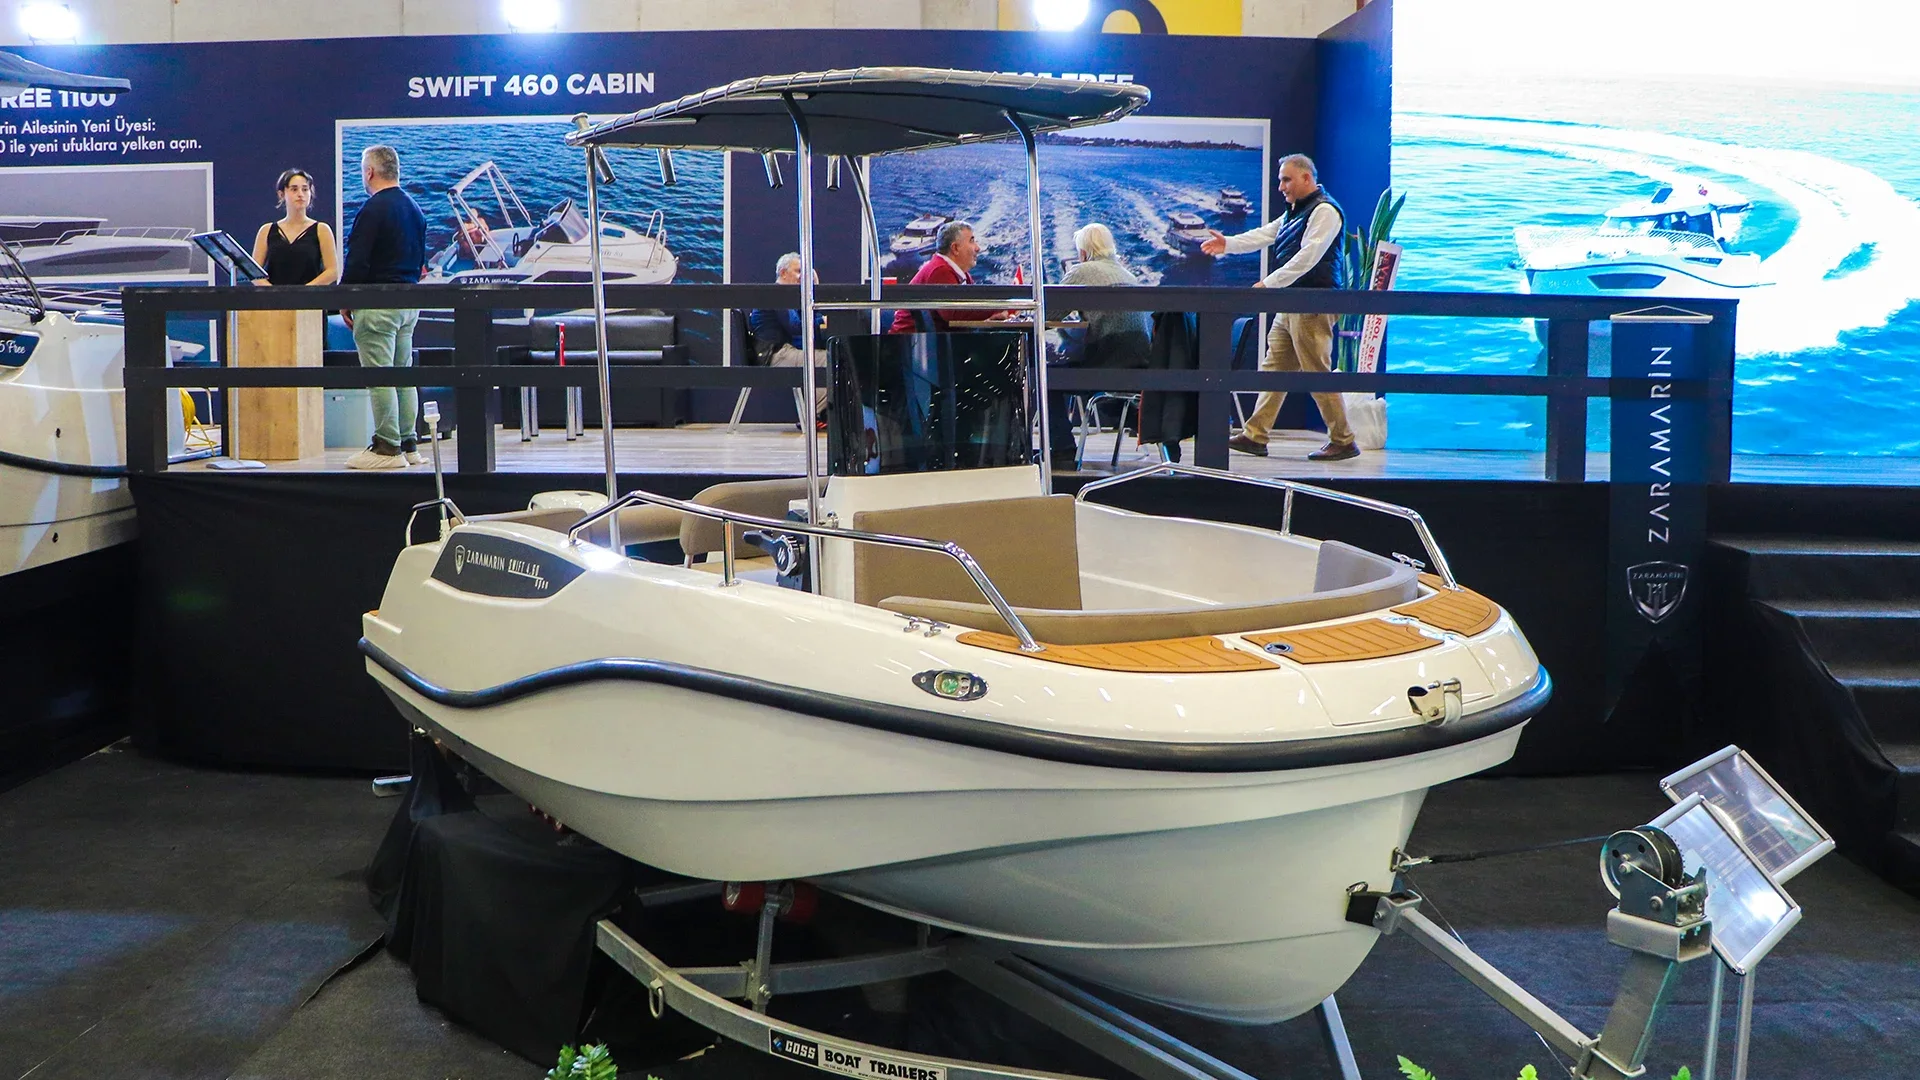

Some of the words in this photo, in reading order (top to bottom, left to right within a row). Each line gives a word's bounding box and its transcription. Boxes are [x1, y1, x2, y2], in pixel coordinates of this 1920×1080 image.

[0, 87, 52, 109] REE
[408, 76, 497, 98] SWIFT
[504, 74, 559, 96] 460
[566, 72, 655, 95] CABIN
[0, 121, 17, 134] rin
[21, 119, 78, 134] Ailesinin
[82, 119, 110, 133] Yeni
[115, 115, 156, 136] Üyesi:
[10, 138, 26, 153] ile
[30, 139, 58, 156] yeni
[62, 136, 117, 152] ufuklara
[122, 135, 165, 155] yelken
[169, 139, 202, 153] açın.
[1371, 315, 1382, 341] ROL
[1366, 344, 1376, 373] SEV
[785, 1040, 816, 1060] COSS
[824, 1049, 861, 1069] BOAT
[869, 1060, 938, 1080] TRAILERS
